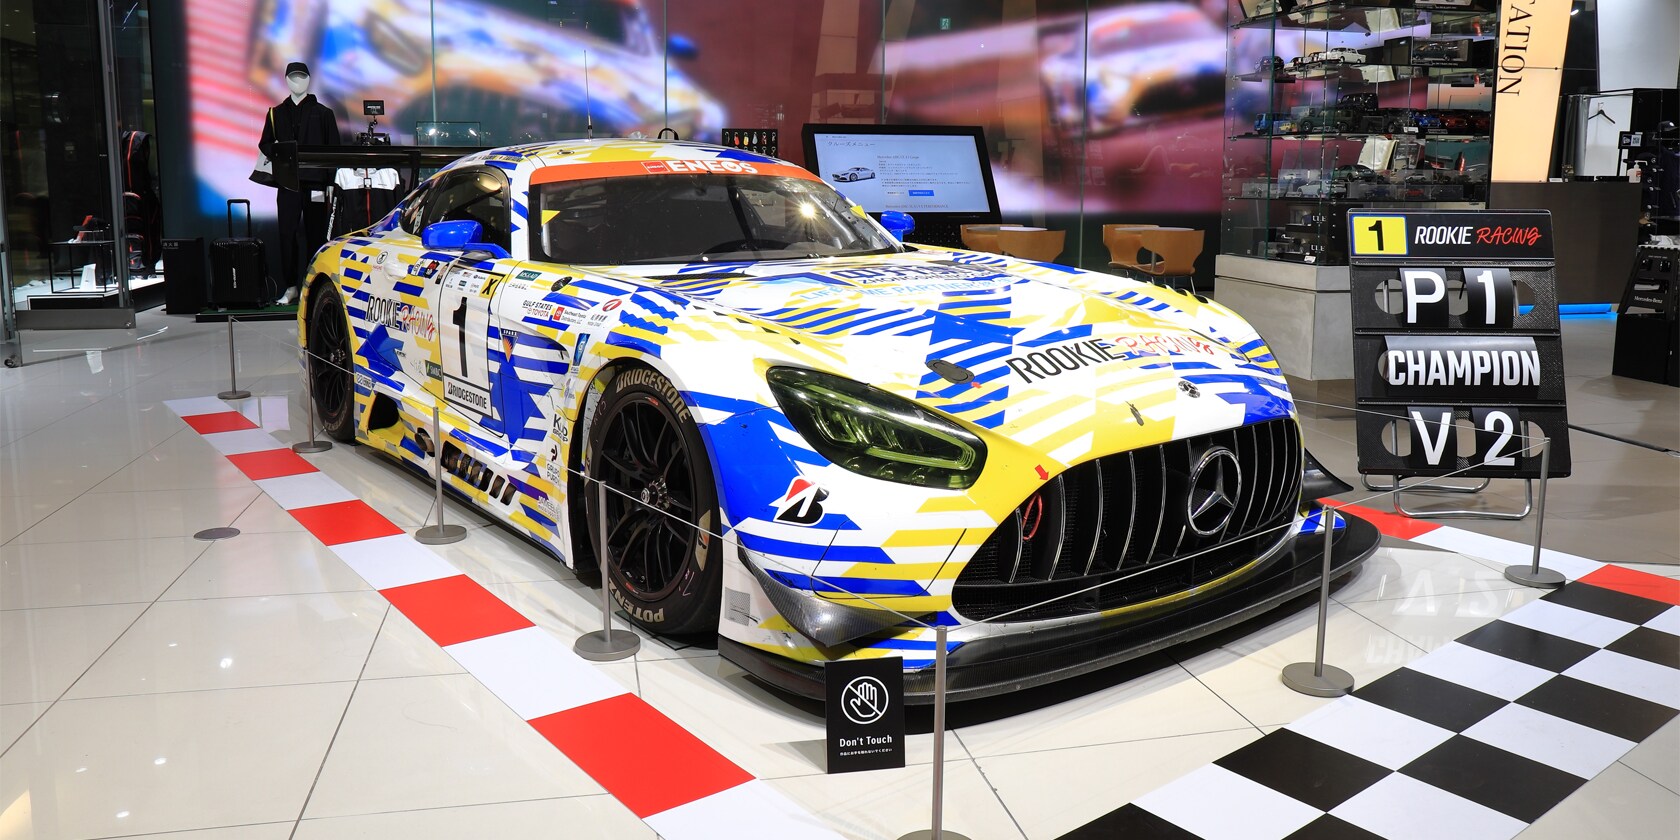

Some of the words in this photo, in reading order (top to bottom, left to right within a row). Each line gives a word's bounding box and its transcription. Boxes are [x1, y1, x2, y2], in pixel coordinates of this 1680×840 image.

[1497, 0, 1535, 96] ATION
[665, 160, 758, 174] ENEOS
[1368, 219, 1384, 251] 1
[1414, 226, 1474, 245] ROOKIE
[1476, 226, 1542, 246] RACING
[482, 278, 498, 295] X
[892, 282, 974, 294] PARTNER
[1404, 270, 1445, 324] P
[1477, 270, 1496, 324] 1
[365, 296, 401, 329] ROOKIE
[400, 305, 436, 342] RACING
[532, 309, 550, 318] TOYOTA
[535, 301, 553, 311] STATES
[452, 296, 468, 377] 1
[1006, 338, 1126, 384] ROOKIE
[1115, 335, 1215, 356] RACING
[1387, 350, 1541, 386] CHAMPION
[447, 382, 488, 409] BRIDGESTONE
[616, 368, 692, 423] BRIDGESTONE
[1411, 411, 1452, 466] V
[1484, 410, 1516, 467] 2
[608, 578, 665, 622] POTENZ
[840, 737, 863, 747] Don't
[866, 734, 892, 745] Touch
